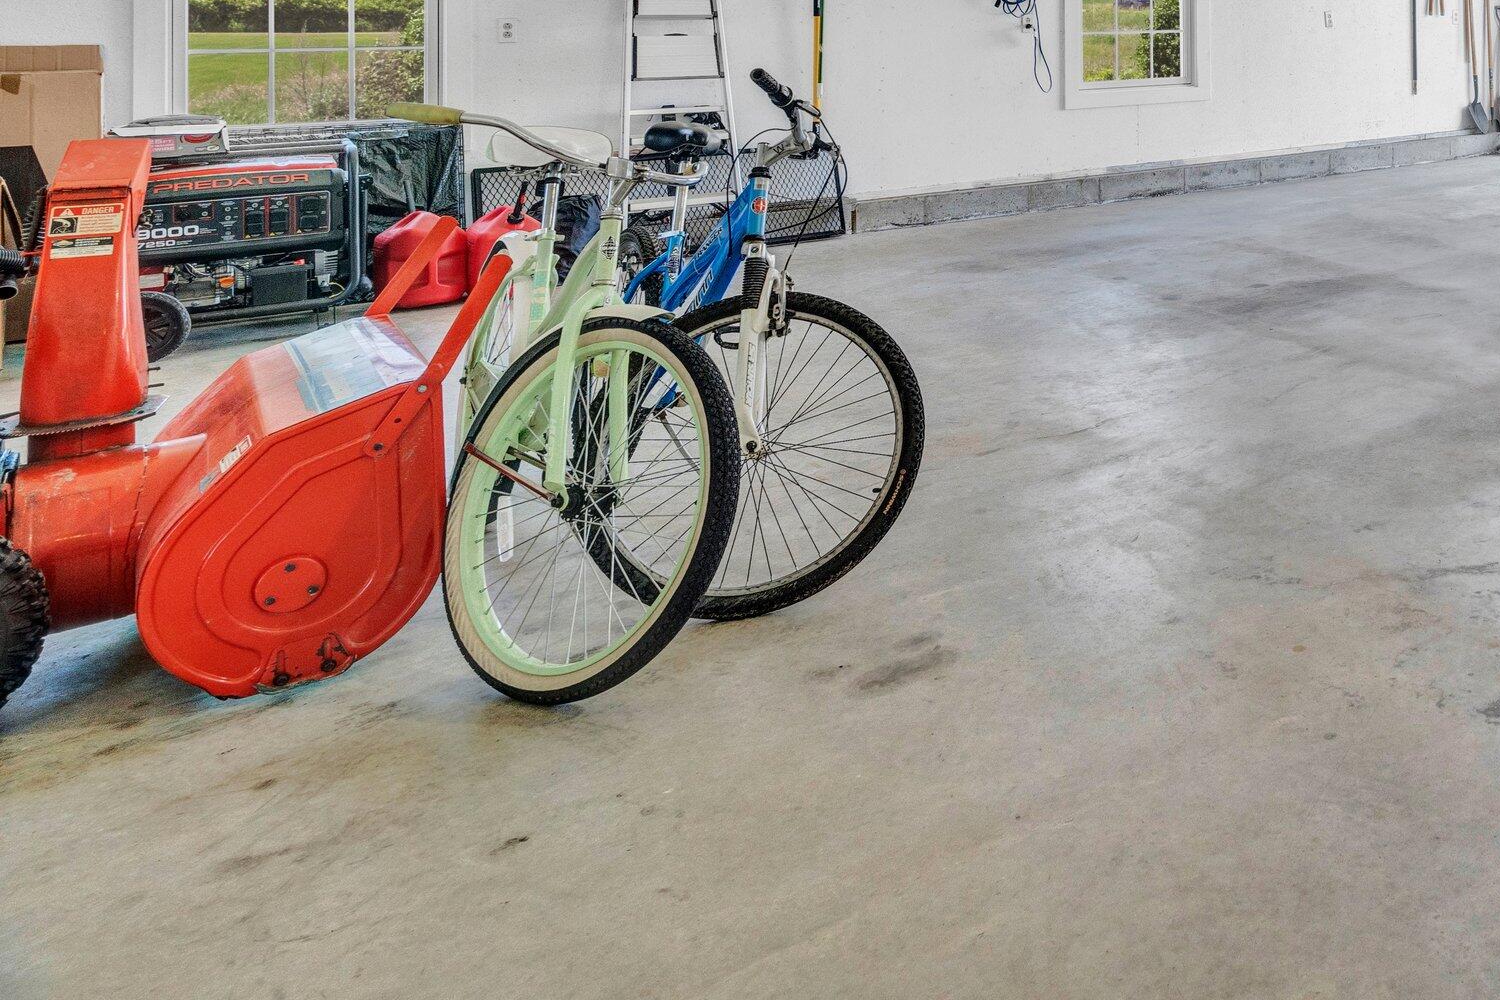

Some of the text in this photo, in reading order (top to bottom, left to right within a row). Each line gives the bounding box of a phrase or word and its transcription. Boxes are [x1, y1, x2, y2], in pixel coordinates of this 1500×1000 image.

[153, 173, 309, 194] PREDATOR
[81, 206, 115, 215] DANGER
[138, 225, 200, 240] 9000
[138, 239, 176, 250] 7250
